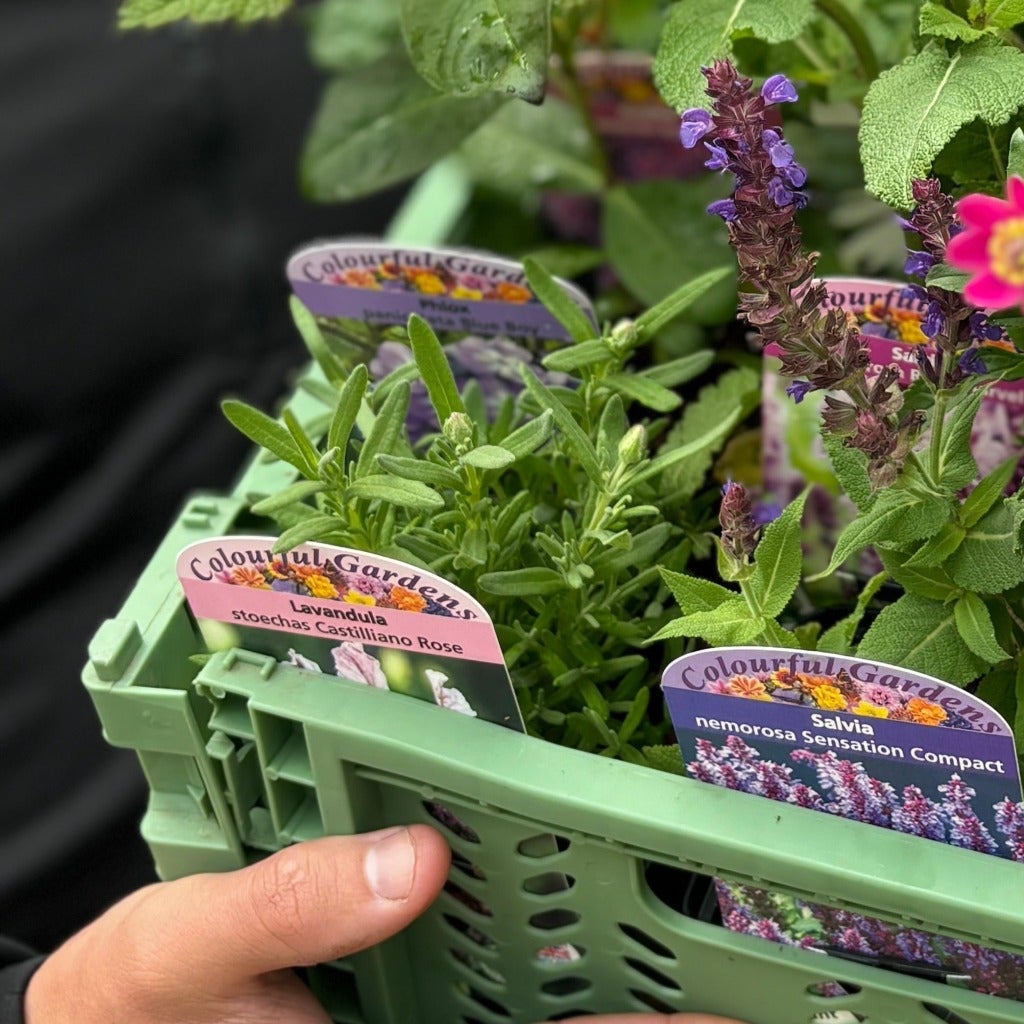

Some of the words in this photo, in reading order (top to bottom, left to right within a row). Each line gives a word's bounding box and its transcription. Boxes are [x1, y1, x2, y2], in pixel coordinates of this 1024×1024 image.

[445, 254, 527, 284] Gard
[334, 553, 478, 621] Gardens
[232, 609, 310, 632] stoechas
[316, 620, 413, 647] Castilliano
[419, 636, 464, 655] Rose
[290, 599, 387, 626] Lavandula
[681, 652, 836, 691] Colourful
[850, 662, 1003, 735] Gardens
[695, 715, 797, 742] nemorosa
[802, 730, 904, 758] Sensation
[910, 747, 1006, 775] Compact
[811, 713, 875, 736] Salvia
